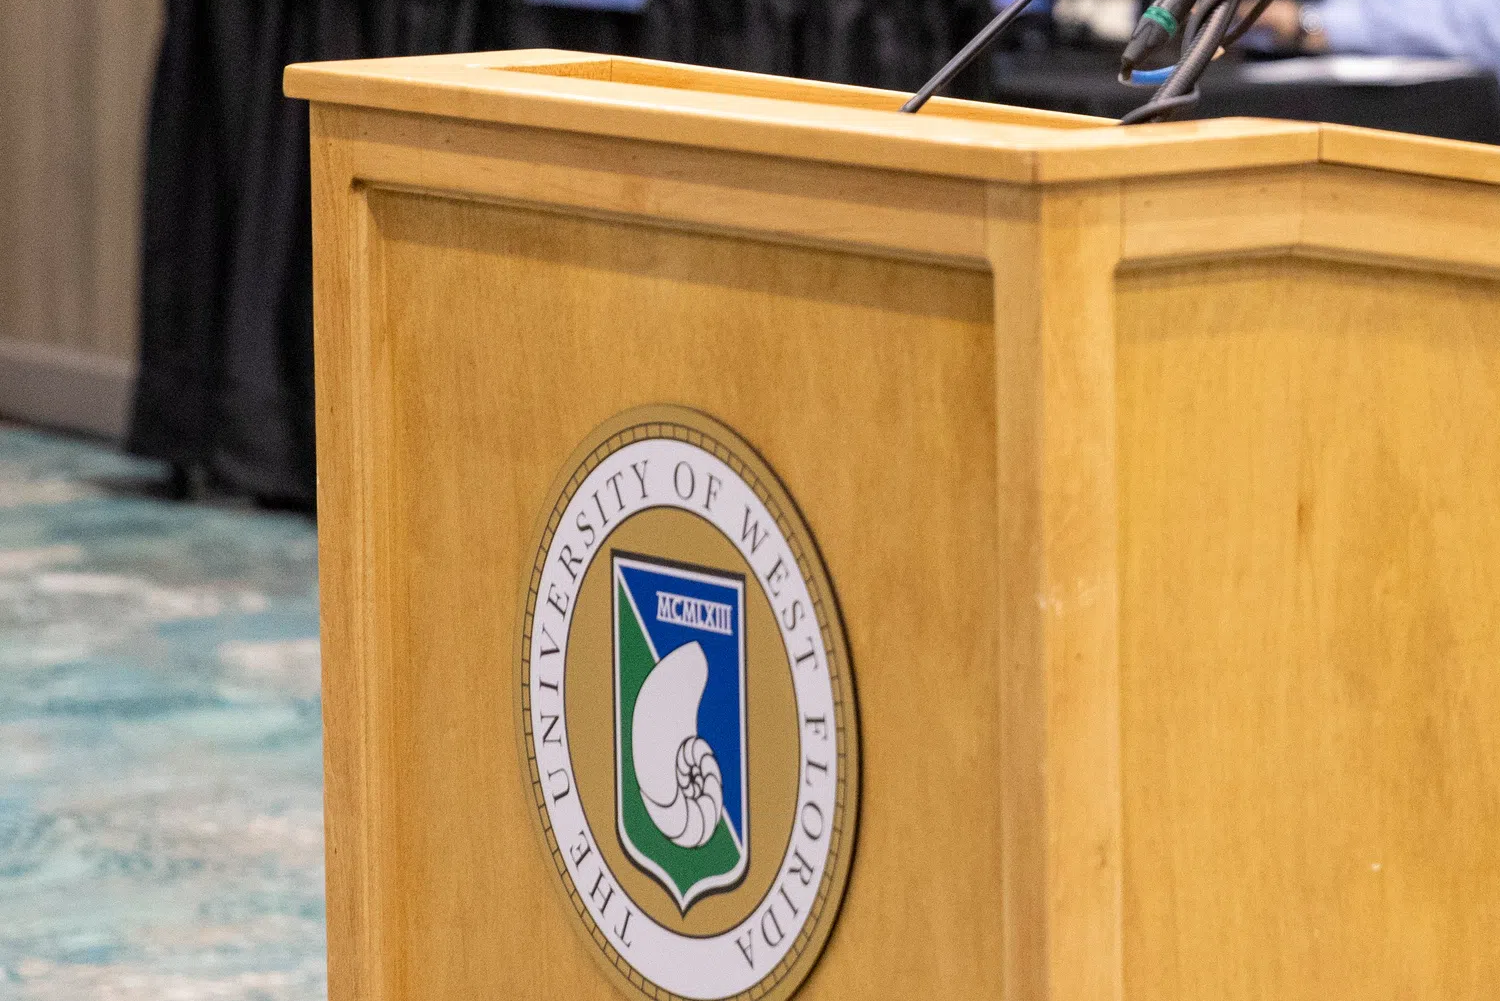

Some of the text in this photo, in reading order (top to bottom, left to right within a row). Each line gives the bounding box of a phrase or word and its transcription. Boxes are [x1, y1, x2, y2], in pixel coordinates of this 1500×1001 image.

[539, 460, 830, 971] THE UNIVERSITY OF WEST FLORIDA
[656, 590, 733, 635] MCMLXIII
